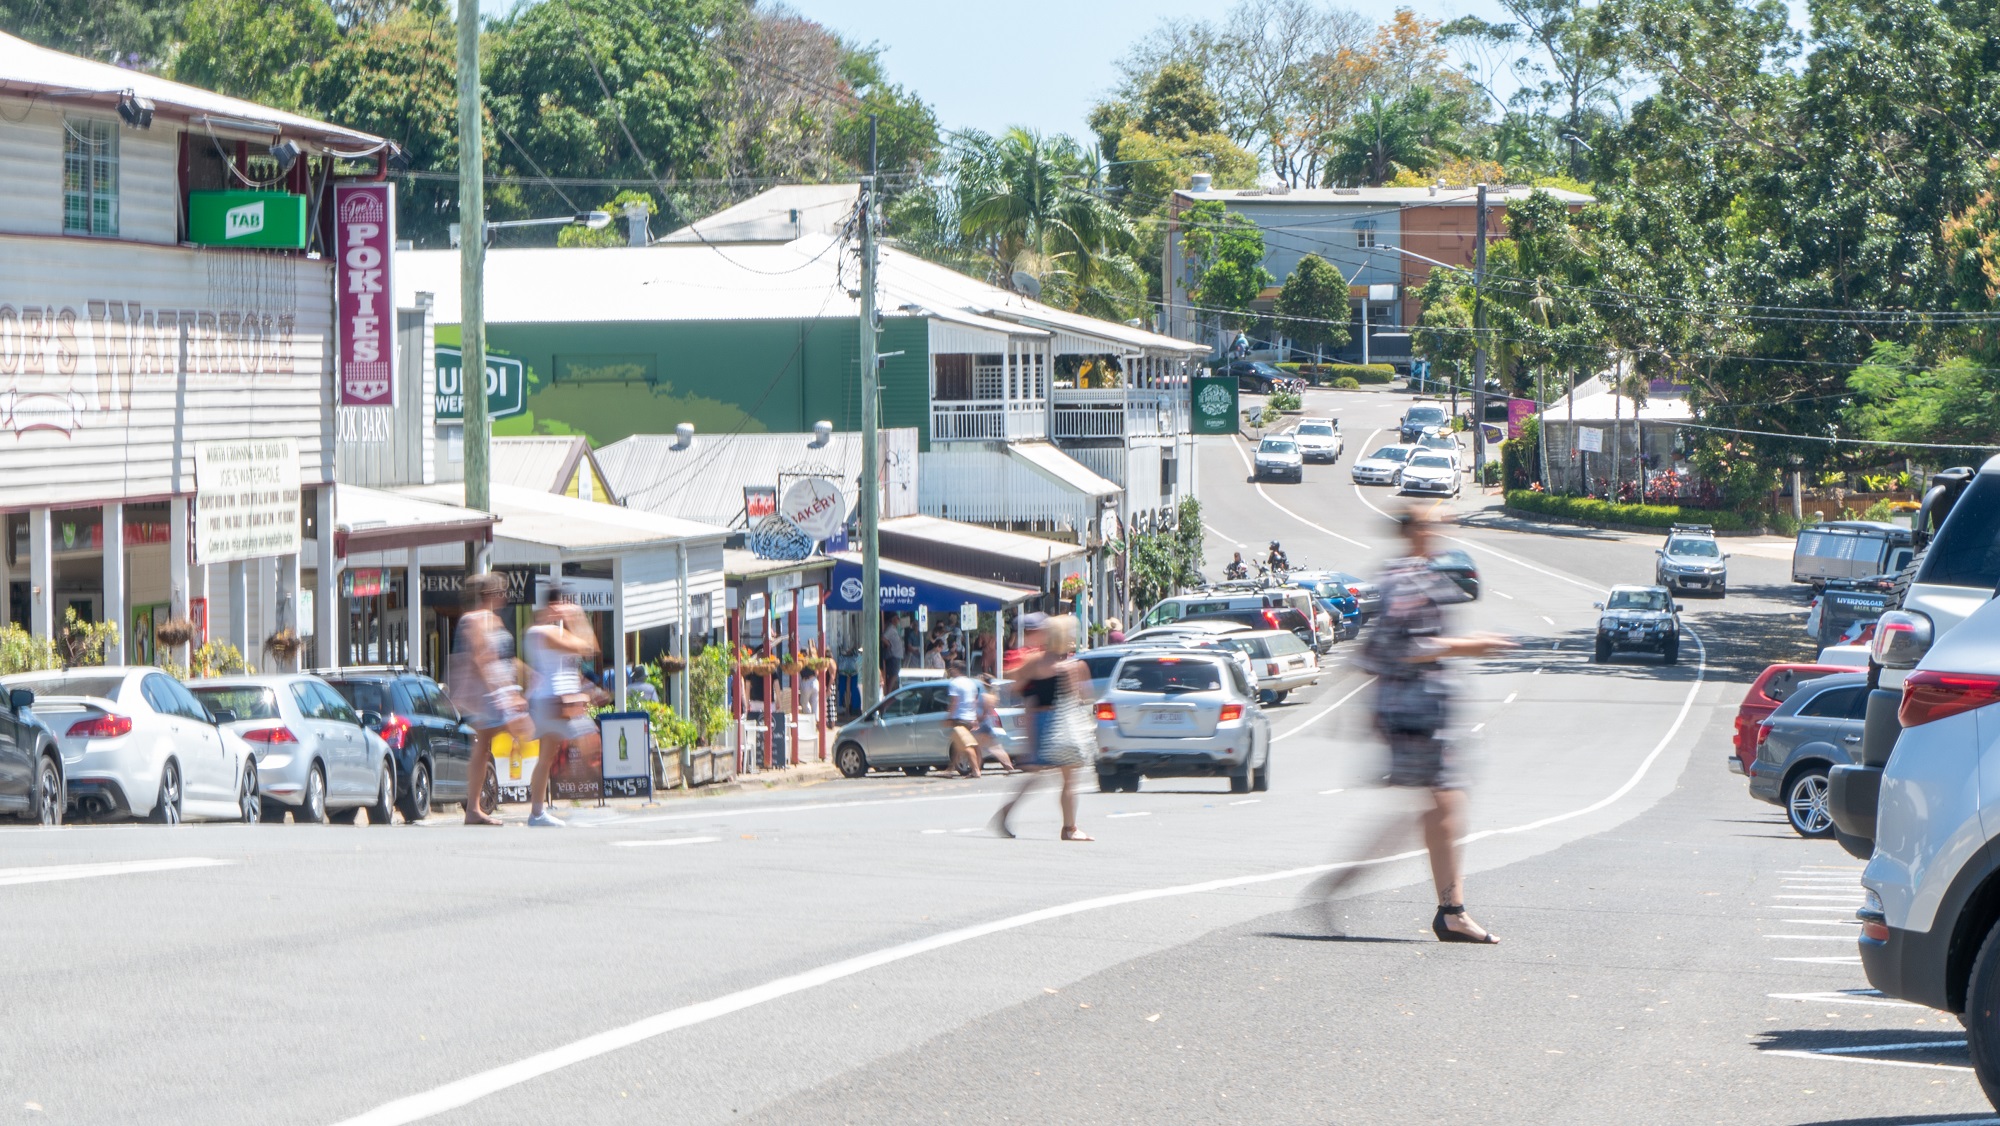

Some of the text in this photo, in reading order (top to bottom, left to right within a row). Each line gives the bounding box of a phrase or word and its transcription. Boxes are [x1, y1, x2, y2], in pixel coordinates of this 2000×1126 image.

[230, 211, 260, 228] TAB
[346, 223, 382, 363] POKIES
[361, 406, 390, 443] BARN
[580, 592, 603, 606] BAKE
